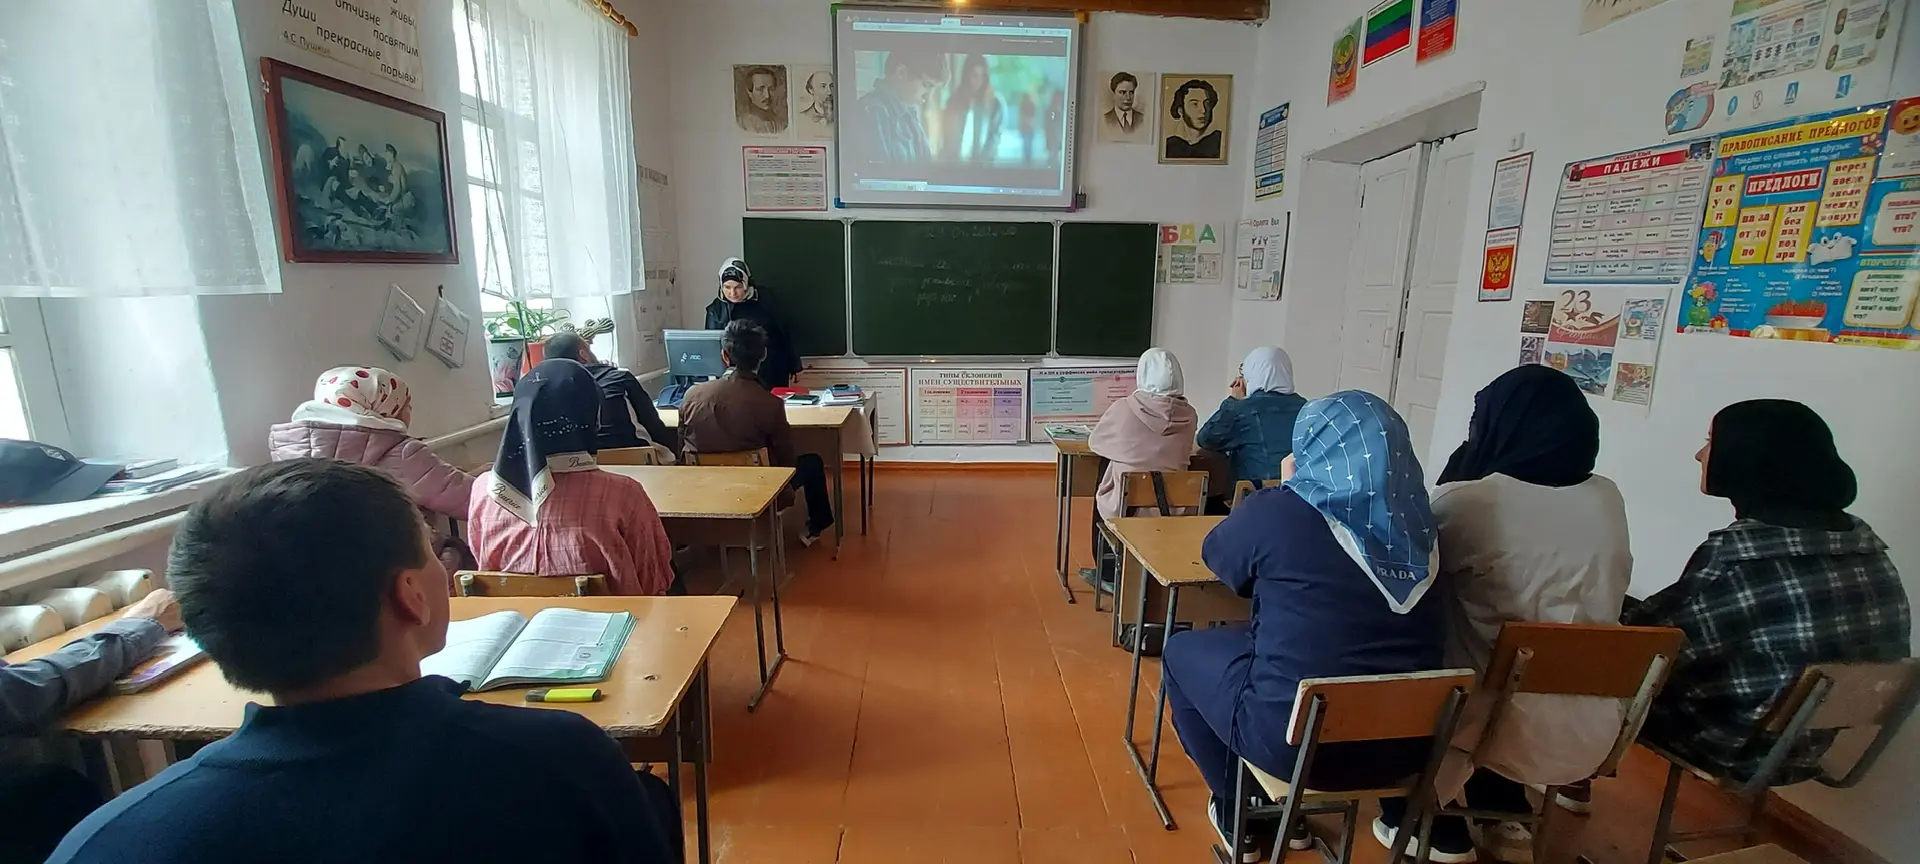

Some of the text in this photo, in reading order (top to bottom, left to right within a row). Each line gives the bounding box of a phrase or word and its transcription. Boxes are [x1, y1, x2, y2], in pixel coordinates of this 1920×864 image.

[282, 0, 317, 22] Души
[316, 25, 381, 60] прекрасные
[373, 29, 419, 57] посвятим
[1721, 116, 1882, 153] ПРАВОПИСАНИЕ ПРЕДЛОГОВ
[1604, 156, 1660, 174] ПАДЕЖИ
[1835, 162, 1867, 173] перед
[1748, 173, 1819, 193] ПРЕДЛОГИ
[1561, 290, 1591, 312] 23
[1522, 335, 1538, 350] 23
